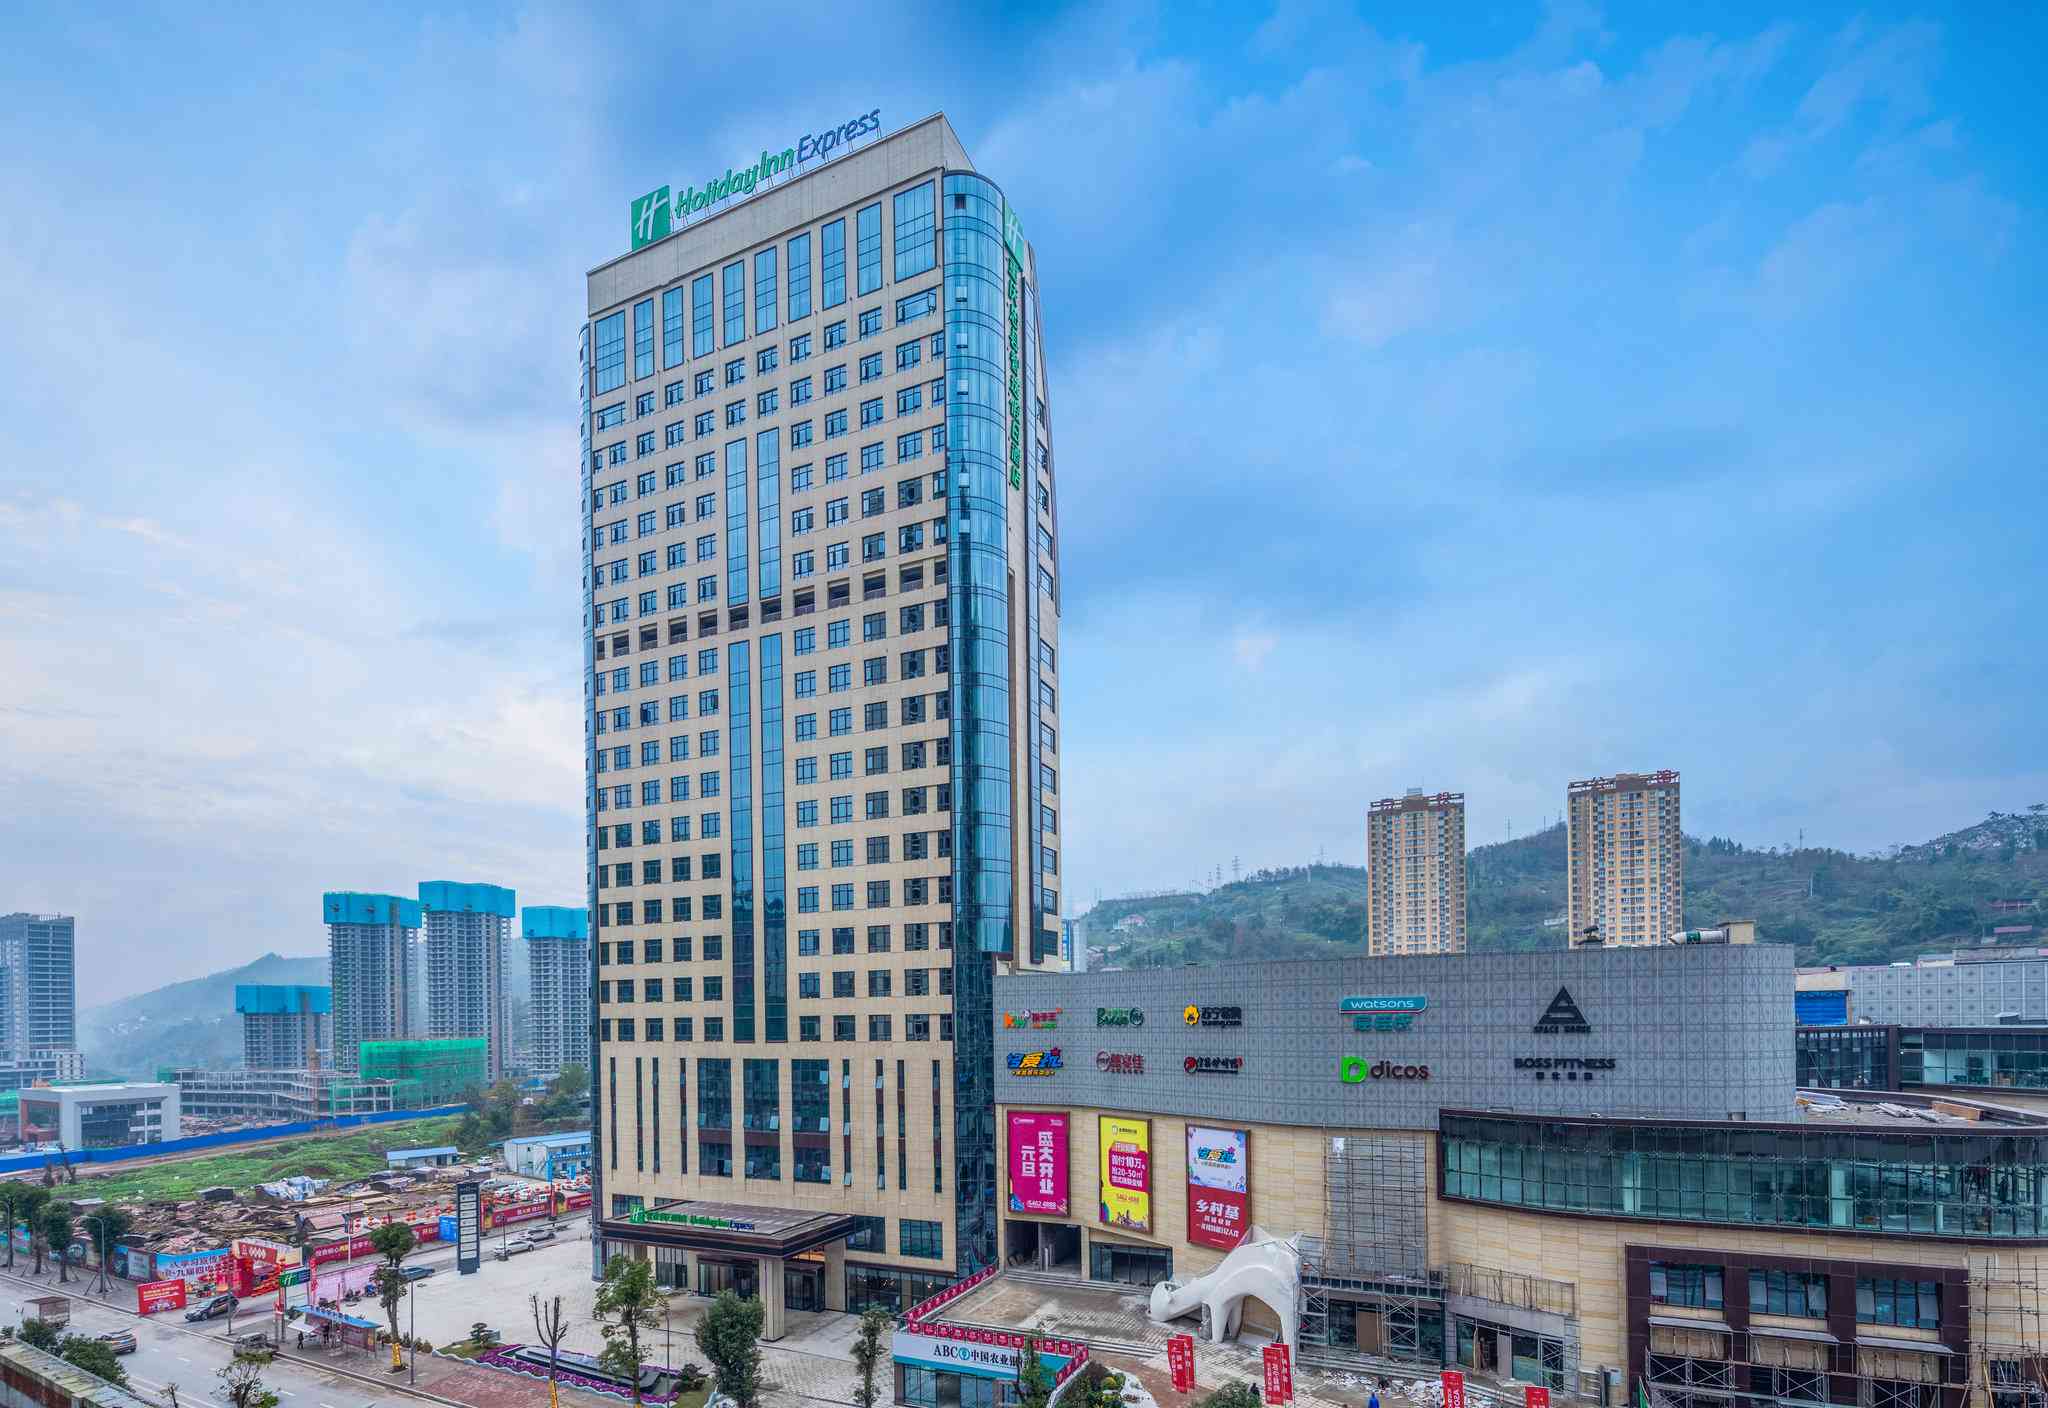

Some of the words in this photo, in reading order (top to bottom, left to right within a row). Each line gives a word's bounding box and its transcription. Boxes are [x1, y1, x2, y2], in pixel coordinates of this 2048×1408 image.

[797, 108, 881, 163] Express
[1350, 1000, 1415, 1009] watsons
[1371, 1060, 1430, 1080] dicos
[1514, 1058, 1553, 1069] BOSS
[1554, 1058, 1617, 1070] FITNESS
[1021, 1145, 1036, 1177] 元旦
[1038, 1131, 1054, 1195] 盛大开业
[933, 1344, 958, 1358] ABC
